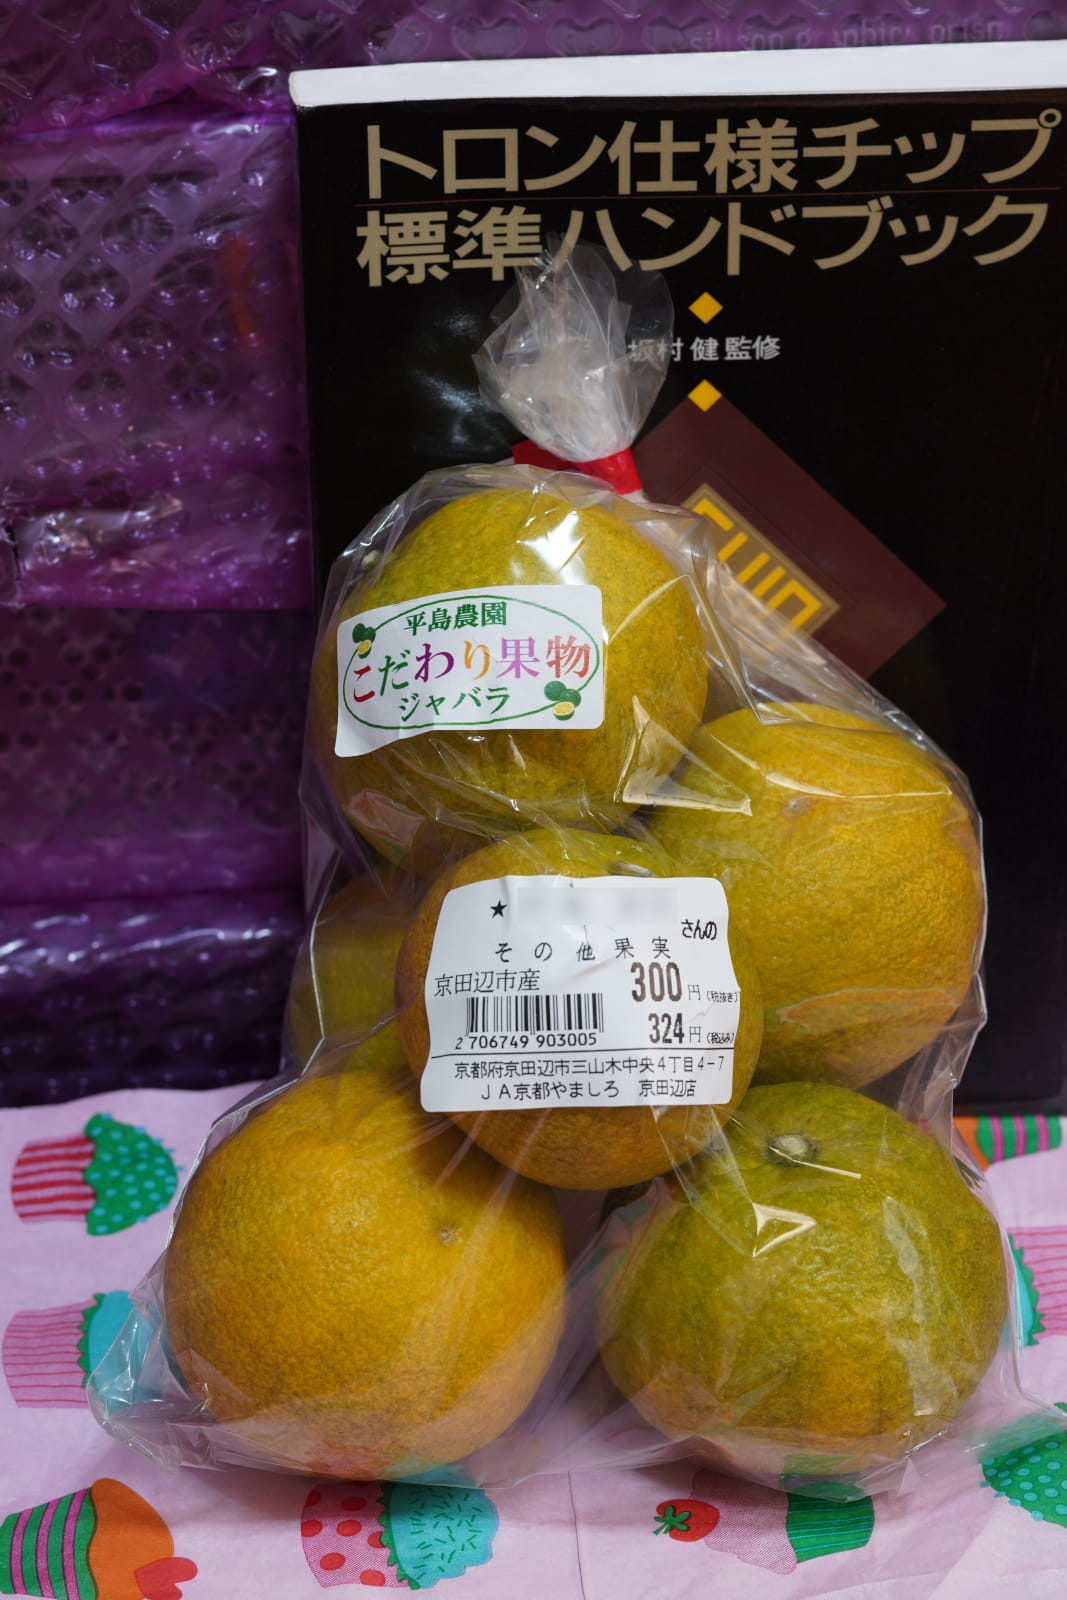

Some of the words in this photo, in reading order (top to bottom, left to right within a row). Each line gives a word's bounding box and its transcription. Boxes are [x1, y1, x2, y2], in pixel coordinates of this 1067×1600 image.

[367, 108, 1062, 199] トロン仕様チップ
[356, 195, 1049, 287] 標準ハンドブック
[403, 601, 508, 636] 平島農園
[353, 635, 592, 703] こだわり果物
[399, 686, 511, 722] ジャバラ
[681, 919, 718, 940] さんの
[495, 936, 672, 962] その他果実
[434, 968, 540, 997] 京田辺市産
[630, 962, 682, 1002] 300
[470, 1035, 529, 1049] 706749
[536, 1033, 597, 1047] 903005
[648, 1012, 685, 1044] 324
[638, 1079, 697, 1098] 京田辺店
